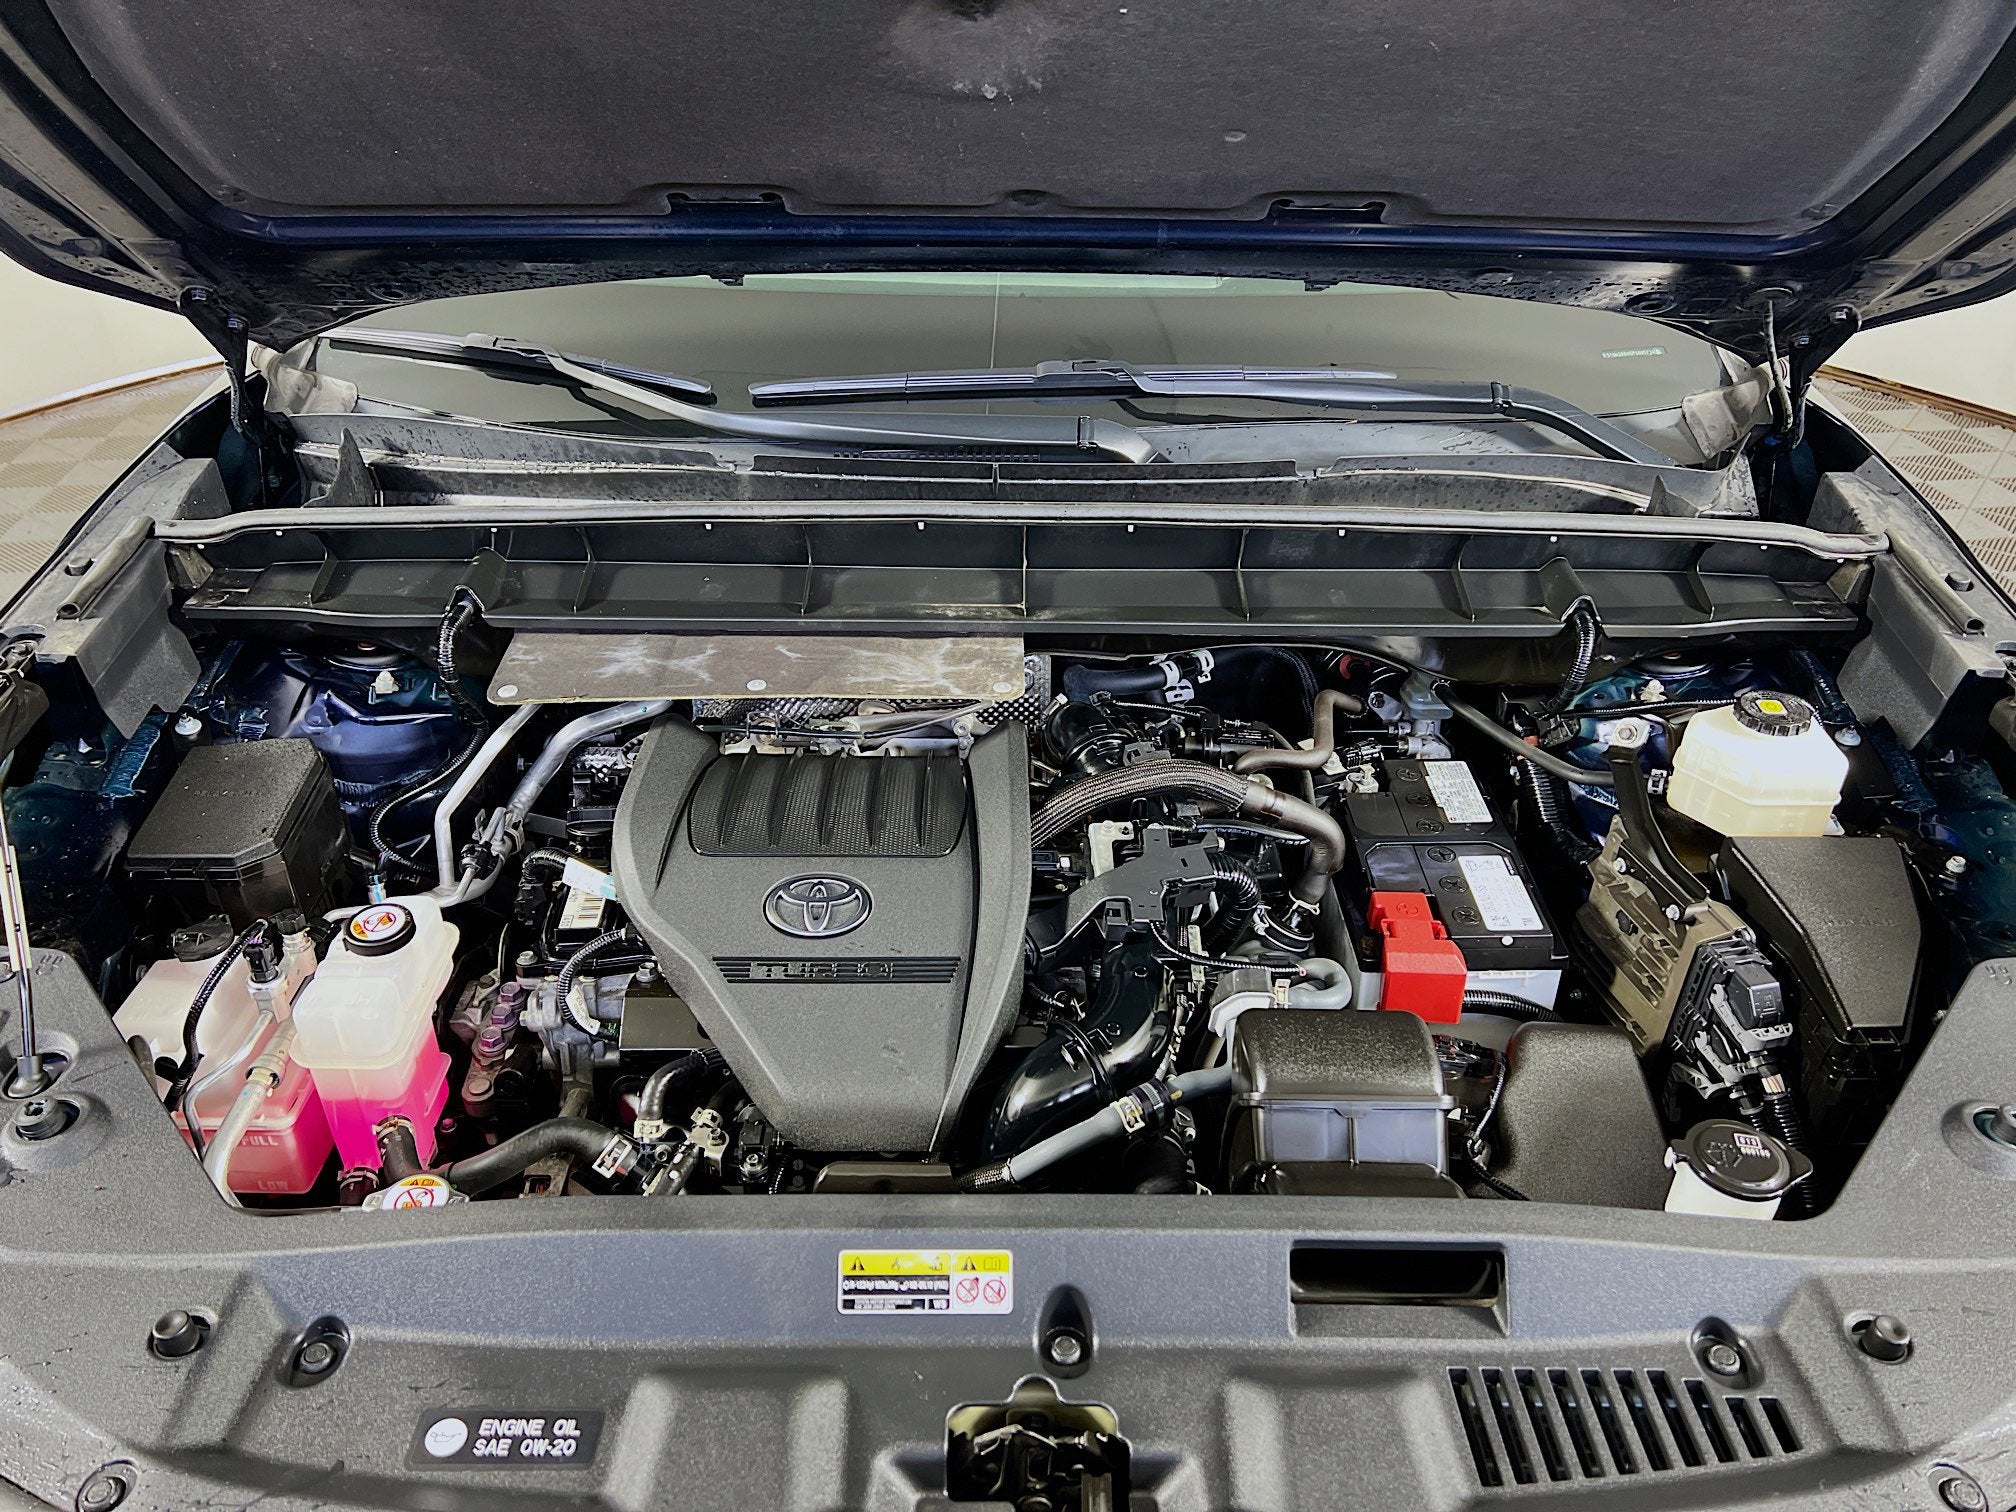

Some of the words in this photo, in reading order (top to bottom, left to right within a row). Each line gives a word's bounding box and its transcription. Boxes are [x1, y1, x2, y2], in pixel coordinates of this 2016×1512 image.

[241, 1135, 278, 1146] FULL
[257, 1180, 288, 1191] LOW
[478, 1418, 545, 1437] ENGINE
[553, 1419, 581, 1437] OIL
[472, 1438, 512, 1457] SAE
[520, 1438, 577, 1457] 0W-20
